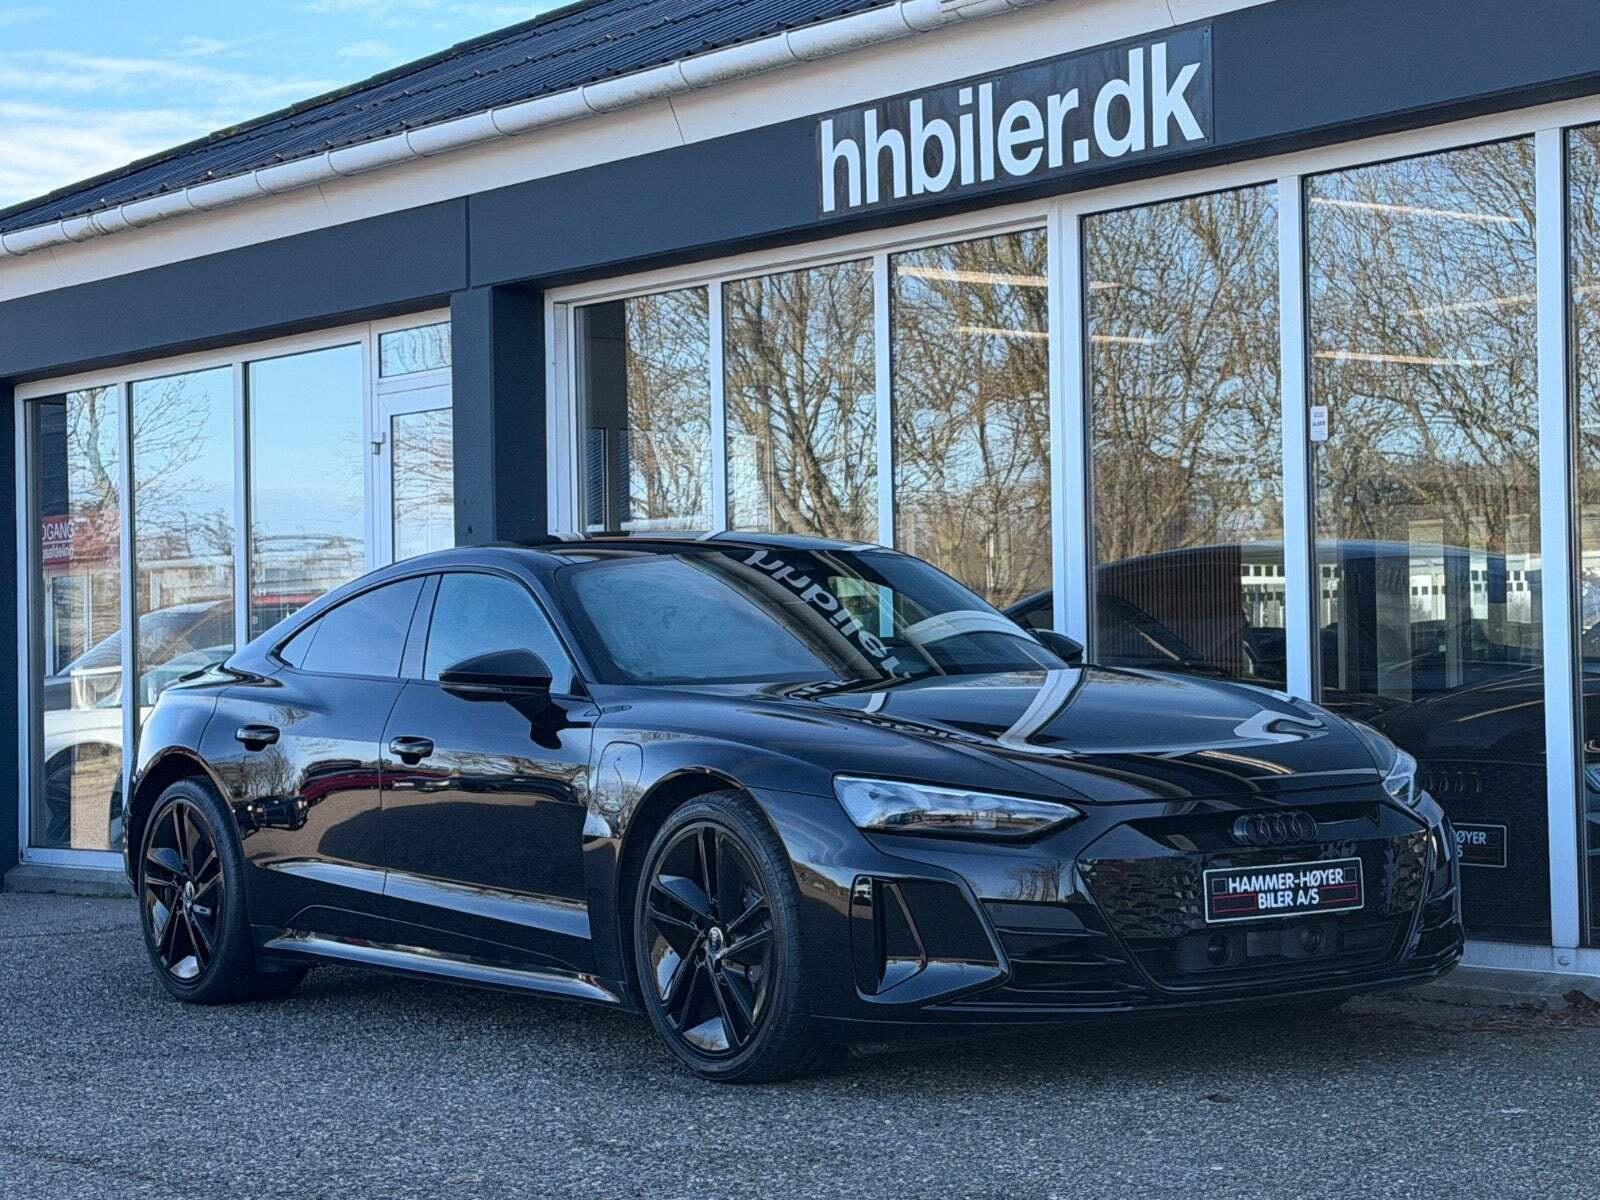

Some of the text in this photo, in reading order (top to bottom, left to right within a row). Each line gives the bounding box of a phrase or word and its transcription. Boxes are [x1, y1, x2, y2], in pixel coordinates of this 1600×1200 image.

[821, 42, 1205, 212] hhbiler.dk
[1228, 868, 1344, 893] HAMMER-HØYER
[1258, 888, 1320, 909] BILER A/S
